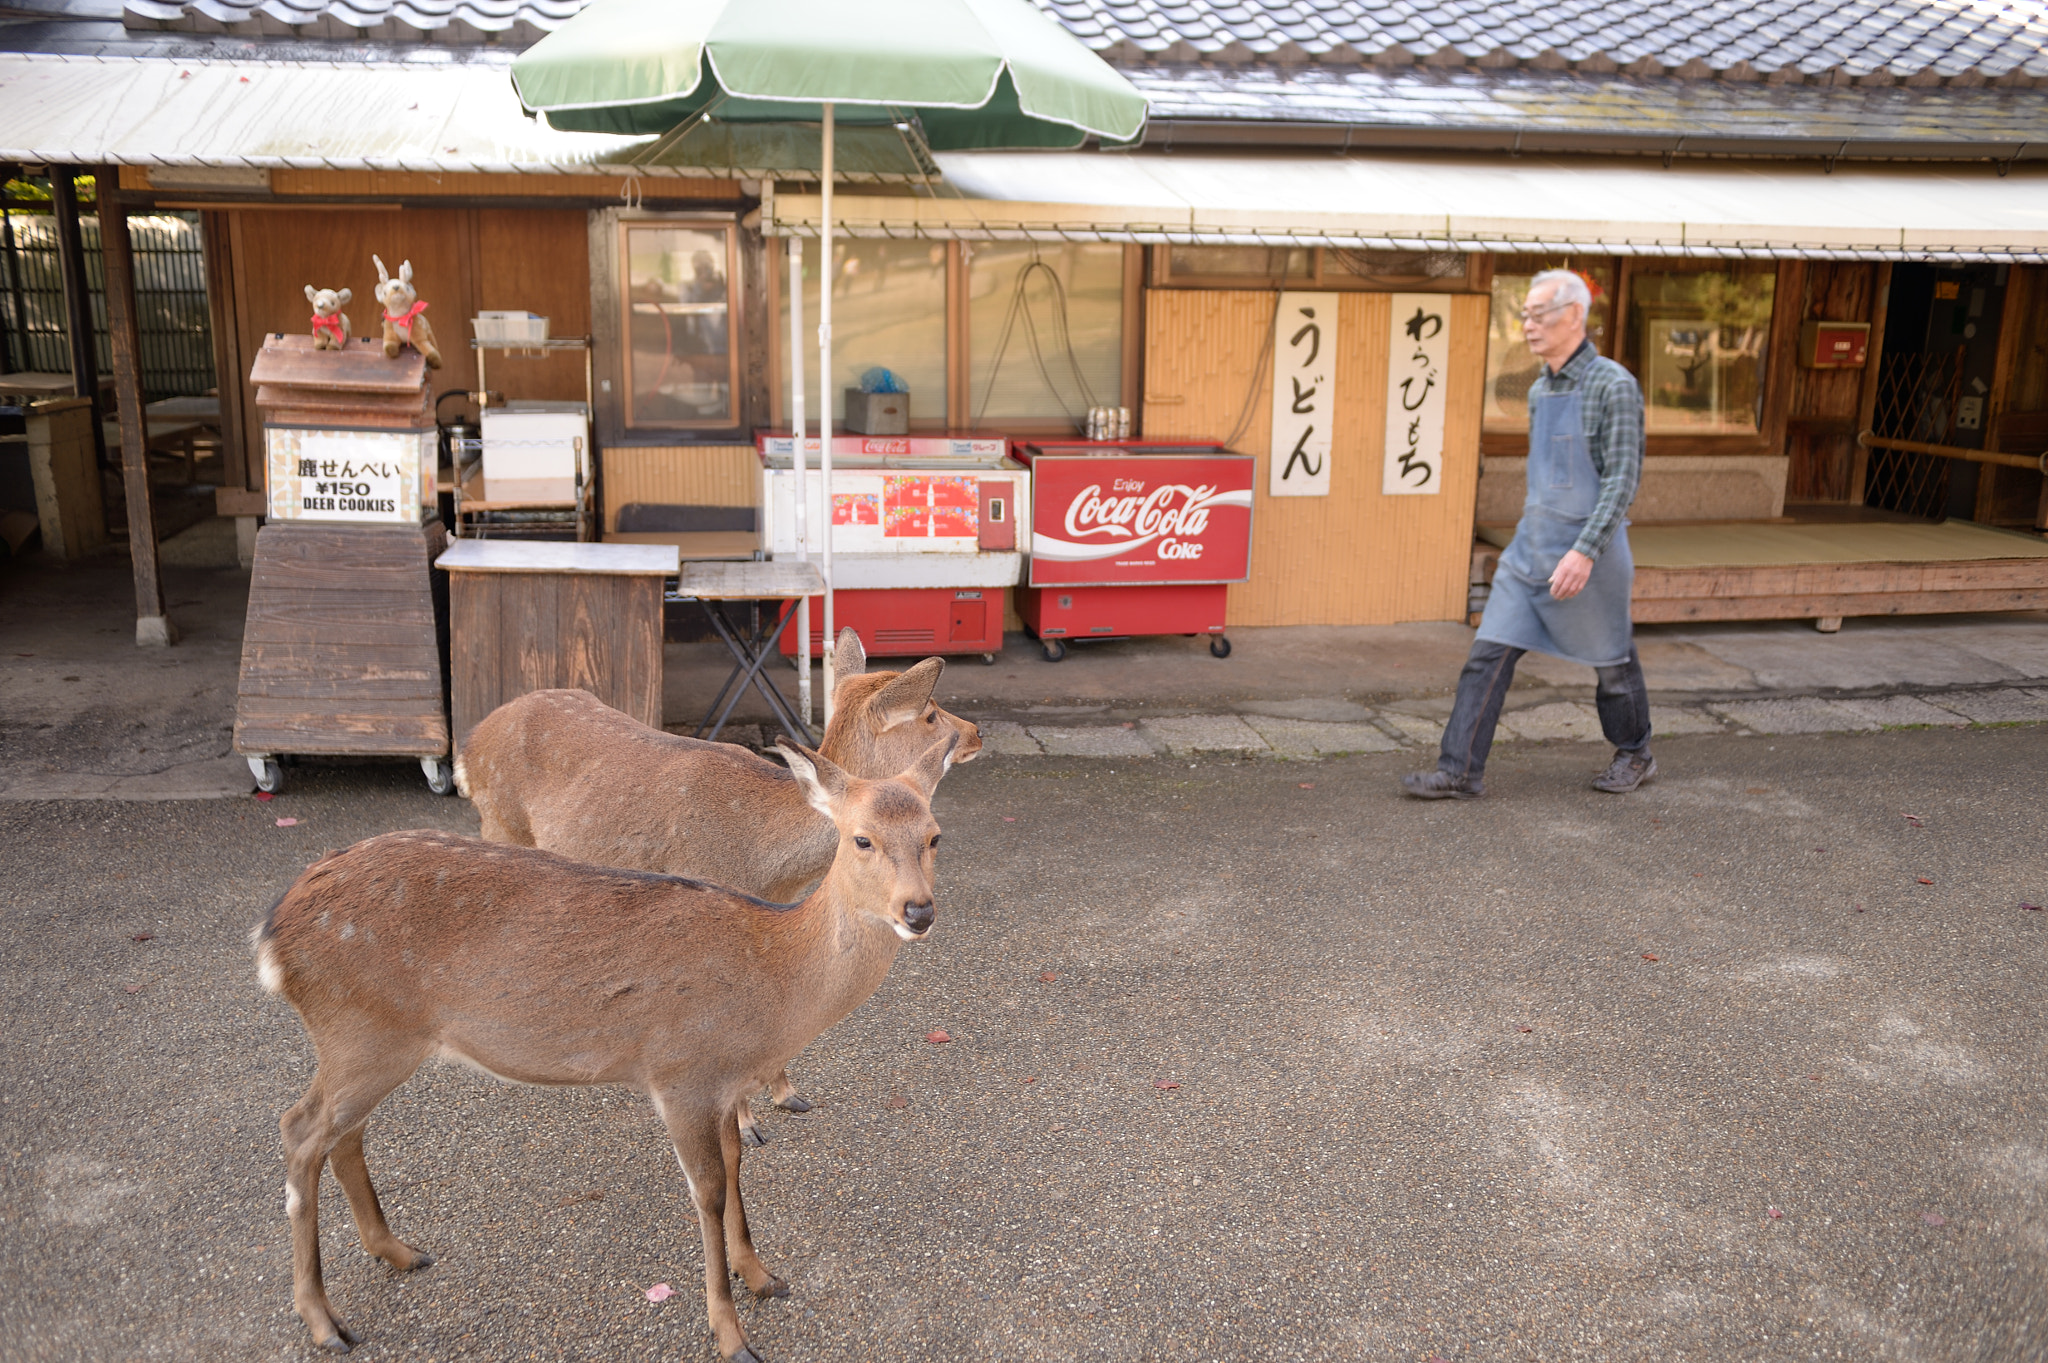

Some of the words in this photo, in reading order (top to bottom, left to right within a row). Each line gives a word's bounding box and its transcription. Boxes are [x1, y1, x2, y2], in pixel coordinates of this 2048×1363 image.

[1282, 307, 1324, 480] うどん
[1397, 307, 1443, 487] わらびもち
[297, 458, 401, 479] 鹿せんべい
[316, 482, 371, 496] ¥150
[1113, 478, 1145, 493] Enjoy
[303, 497, 335, 510] DEER
[339, 498, 395, 512] COOKIES
[1064, 484, 1218, 537] Coca-Cola
[1157, 537, 1204, 560] Coke
